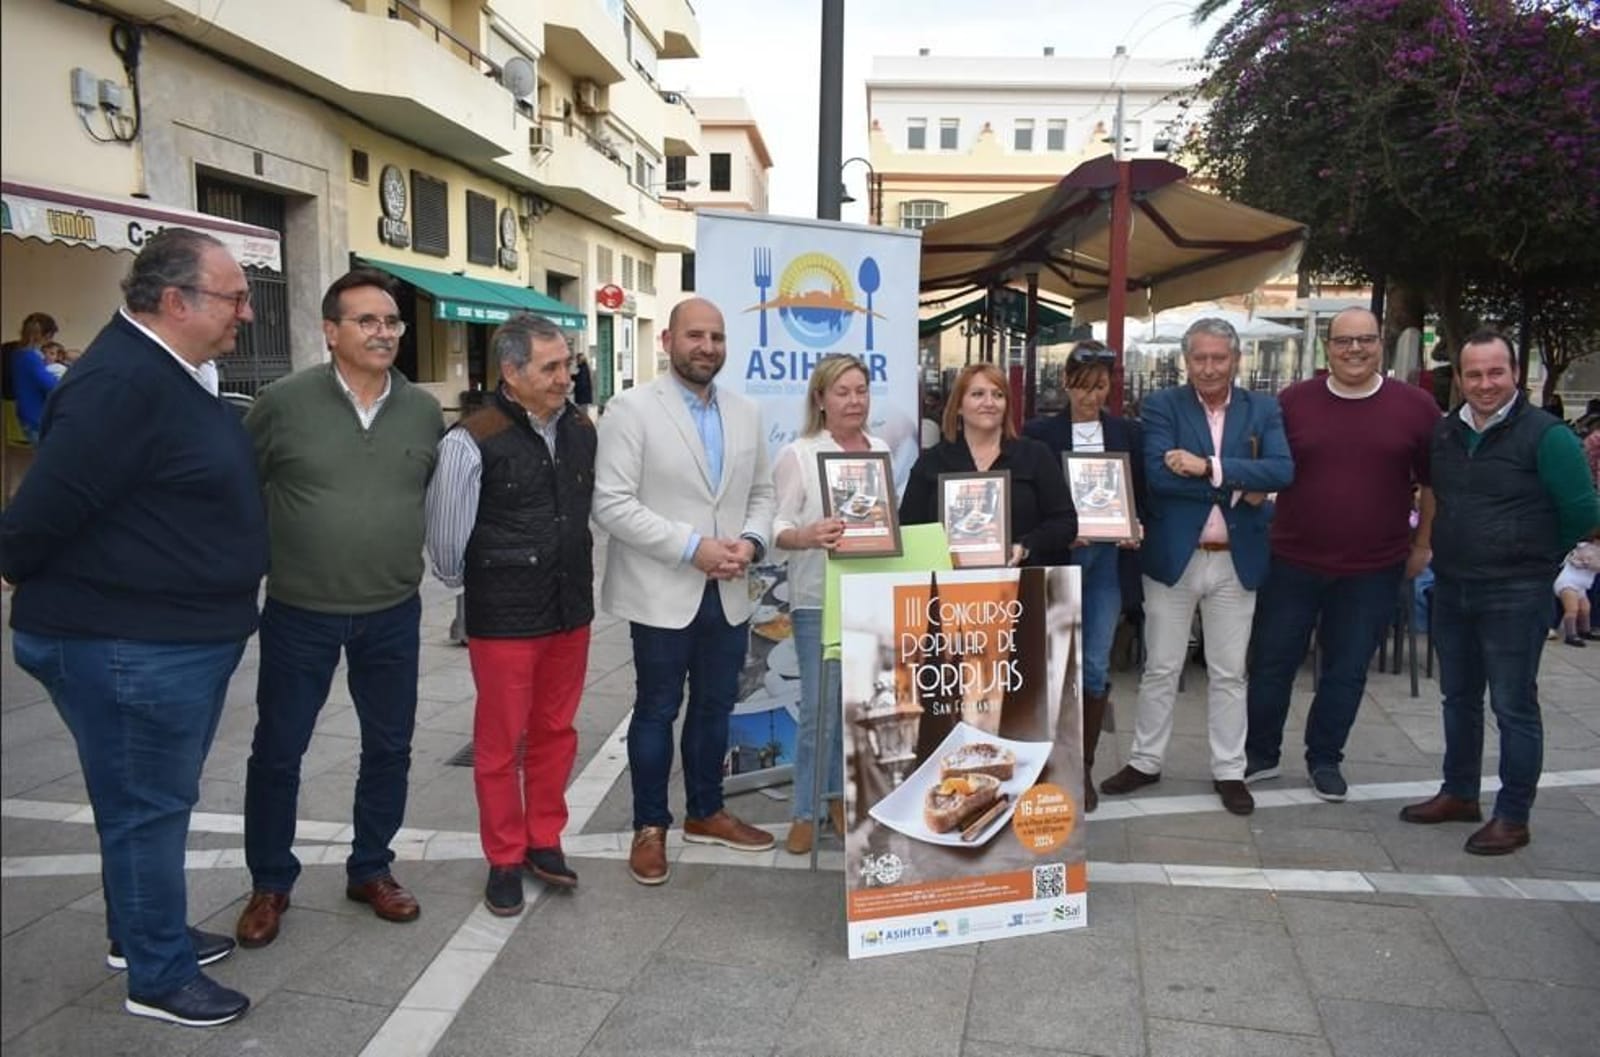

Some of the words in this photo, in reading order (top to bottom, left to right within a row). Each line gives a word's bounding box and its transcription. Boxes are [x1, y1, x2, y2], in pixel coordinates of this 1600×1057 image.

[746, 350, 888, 381] ASIHR
[905, 596, 921, 627] III
[926, 596, 1023, 626] CONCURSO
[901, 629, 988, 663] POPULAR
[997, 629, 1017, 653] DE
[907, 659, 1024, 705] TORRIJAS
[1021, 800, 1032, 816] 16
[1064, 904, 1081, 917] Sal
[885, 925, 932, 941] ASIHTUR
